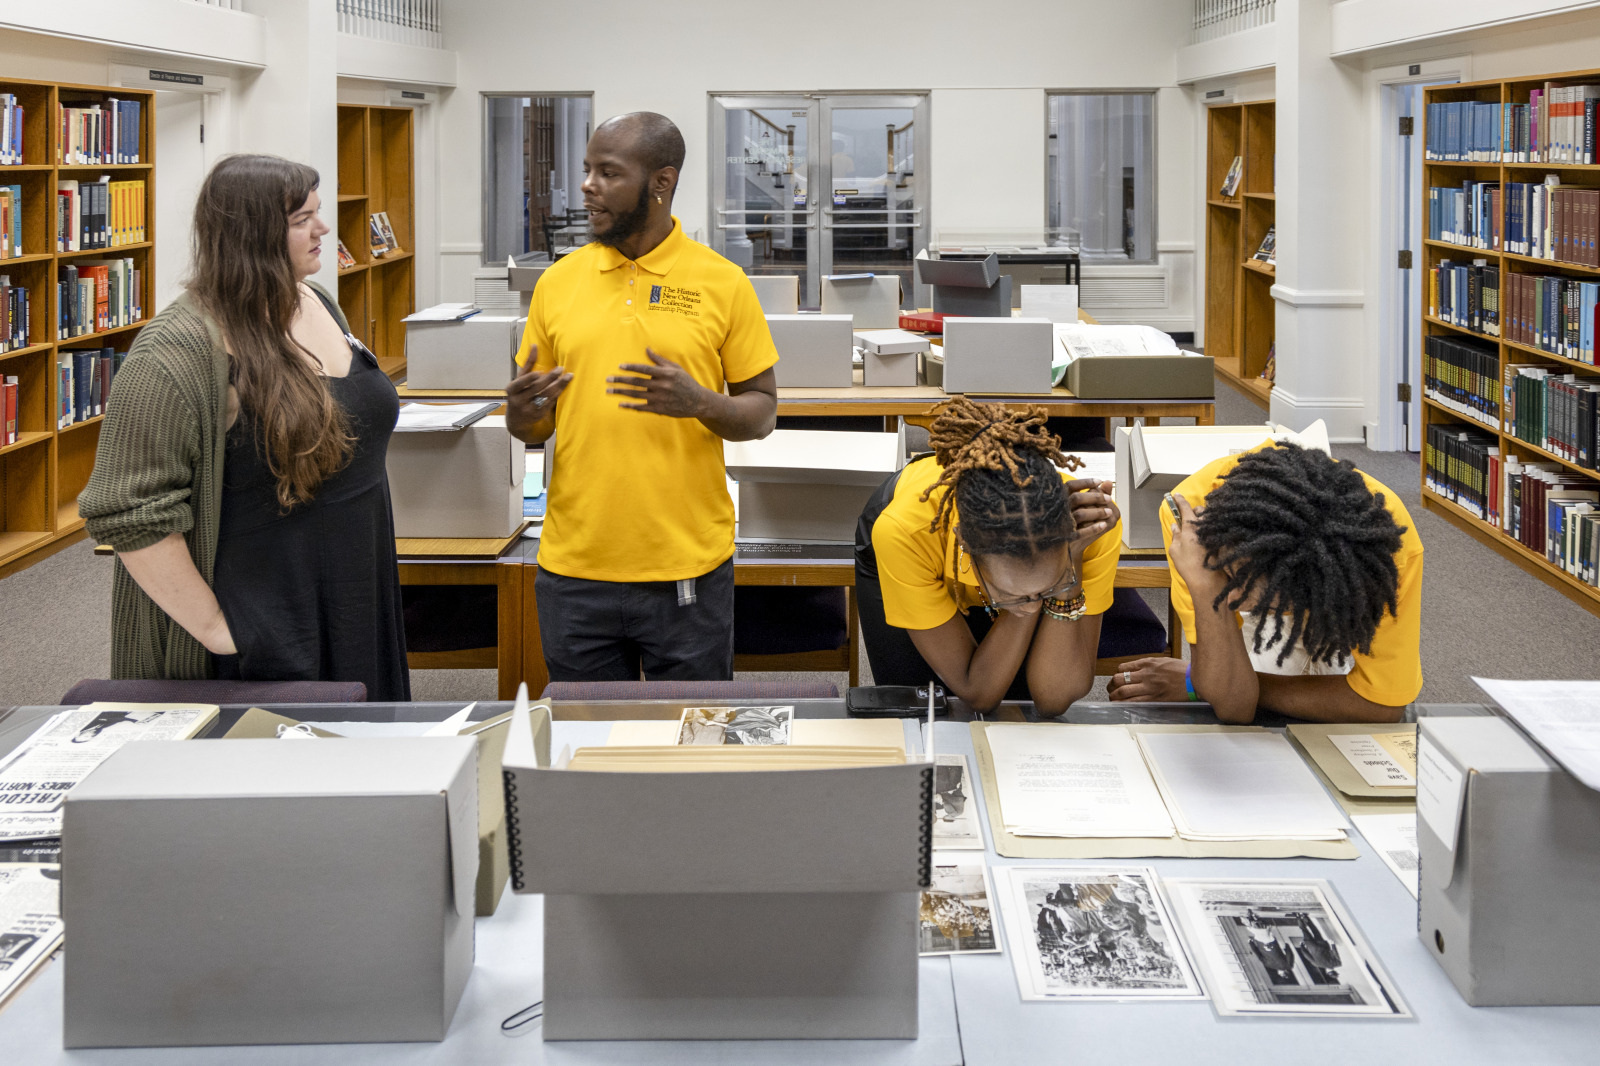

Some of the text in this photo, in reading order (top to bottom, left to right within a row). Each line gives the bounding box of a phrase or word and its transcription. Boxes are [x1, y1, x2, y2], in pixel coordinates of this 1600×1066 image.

[662, 292, 701, 303] New Orleans
[677, 288, 701, 297] Historic
[662, 299, 692, 309] Collection
[648, 304, 700, 316] Internship Program
[0, 782, 76, 791] RIDES NORT
